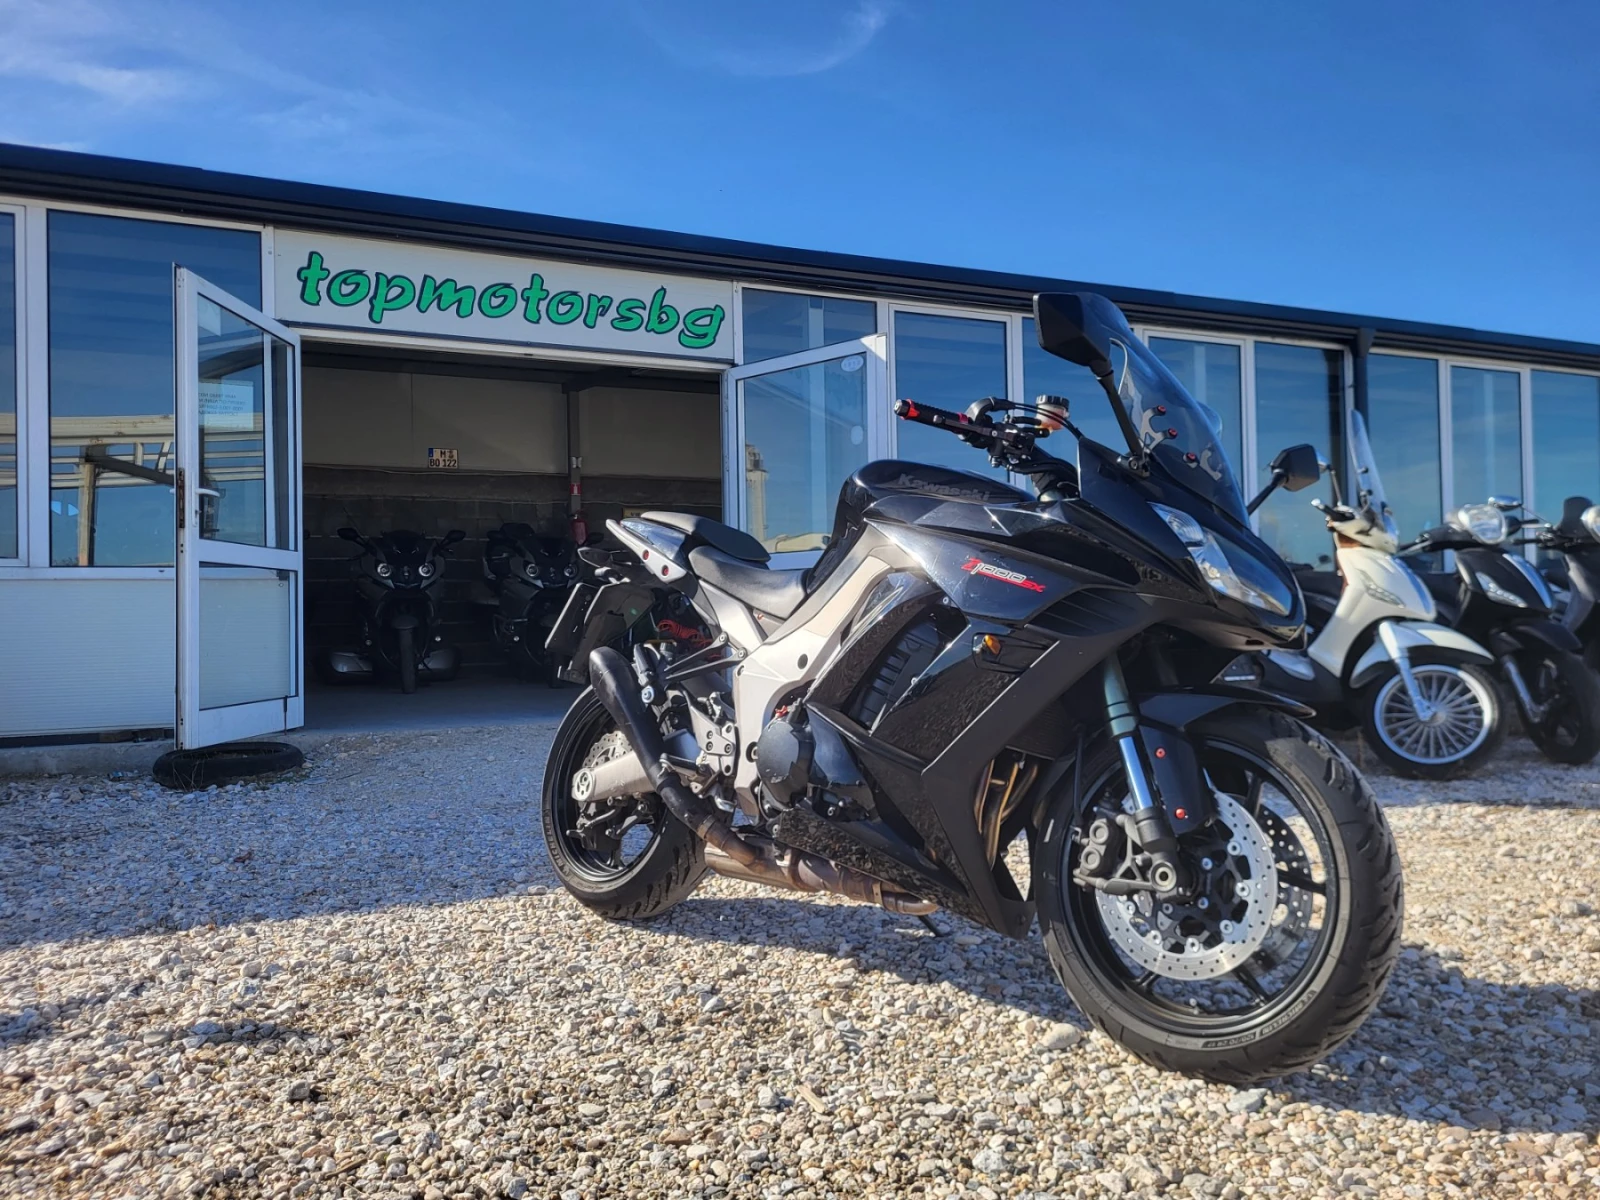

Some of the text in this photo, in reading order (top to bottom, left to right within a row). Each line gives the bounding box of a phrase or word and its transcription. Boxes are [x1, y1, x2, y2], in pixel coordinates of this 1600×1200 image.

[297, 251, 725, 349] topmotorsbg
[442, 459, 457, 467] 122
[898, 474, 990, 501] Kawasaki
[1262, 1001, 1304, 1036] MICHELIN
